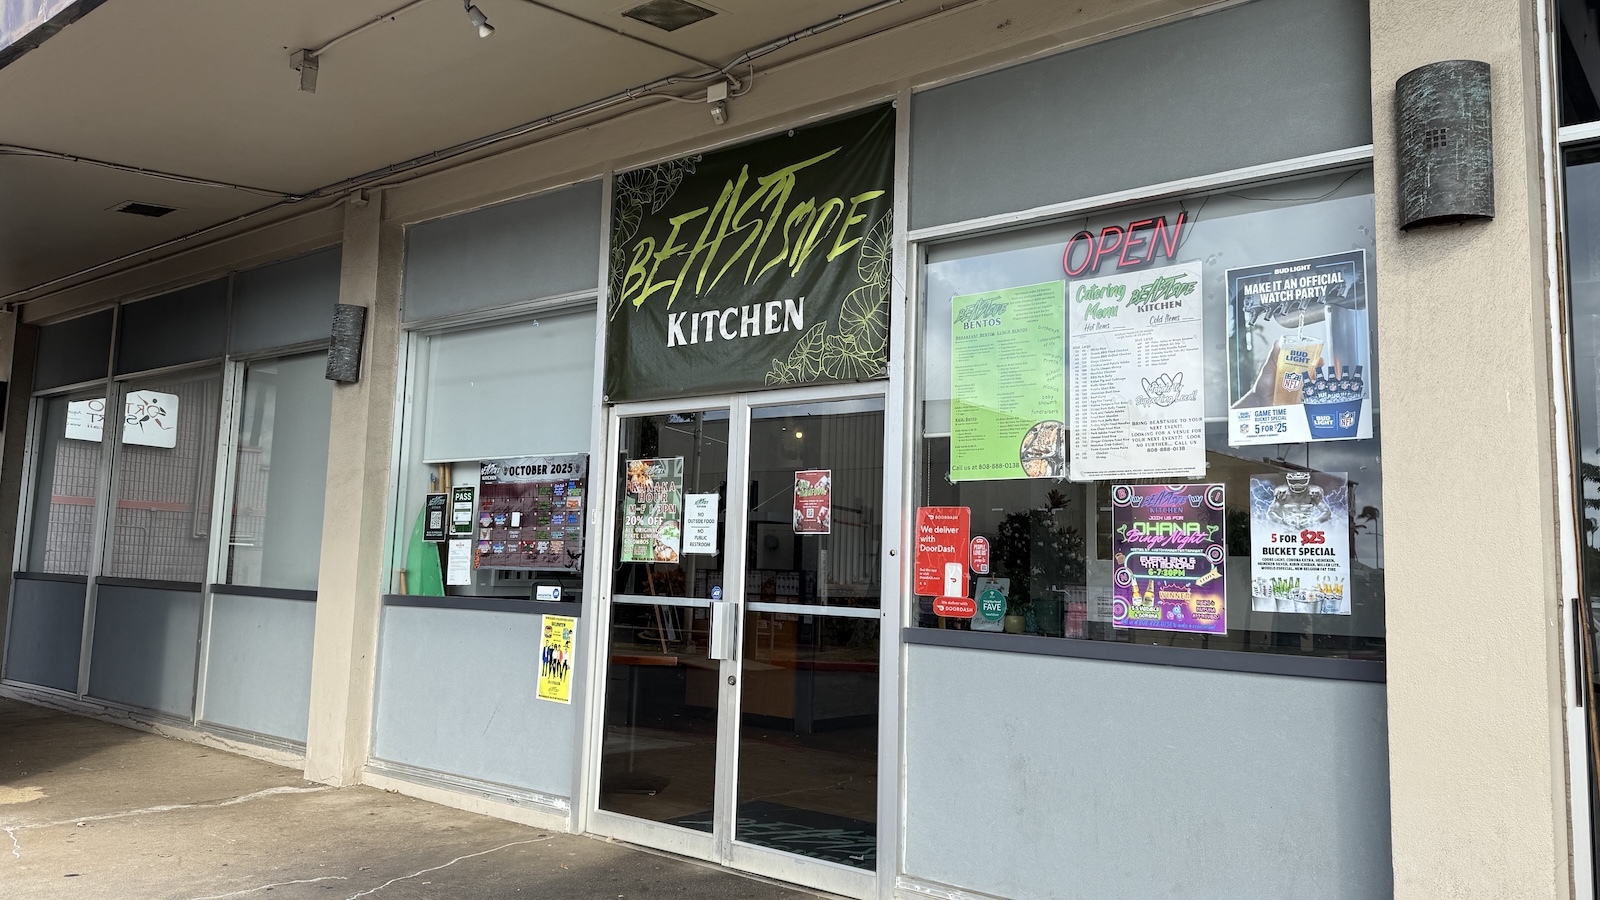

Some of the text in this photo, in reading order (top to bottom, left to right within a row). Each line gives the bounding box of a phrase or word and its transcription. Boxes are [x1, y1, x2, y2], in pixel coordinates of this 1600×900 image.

[611, 146, 885, 322] BEASTSIDE
[1063, 213, 1187, 276] OPEN
[1126, 273, 1198, 308] BEASTSIDE
[1244, 272, 1344, 296] MAKE IT AN OFFICIAL
[1076, 283, 1126, 303] Catering
[1260, 286, 1327, 304] WATCH PARTY
[1084, 302, 1118, 321] Menu
[1137, 300, 1182, 313] KITCHEN
[667, 297, 805, 347] KITCHEN
[964, 318, 1001, 330] BENTOS
[1150, 314, 1180, 325] Cold Items
[1084, 324, 1095, 332] Hot
[1286, 355, 1310, 364] LIGHT
[1285, 380, 1299, 390] NFL
[1255, 424, 1260, 434] 5
[1274, 422, 1287, 432] $25
[509, 463, 573, 476] OCTOBER 2025
[638, 492, 668, 503] HOUR
[626, 516, 664, 525] 20% OFF
[1133, 522, 1200, 536] OHANA
[1126, 529, 1208, 549] Bingo Night
[1271, 529, 1325, 546] 5 FOR $25
[920, 545, 956, 553] DoorDash
[1262, 547, 1336, 556] BUCKET SPECIAL
